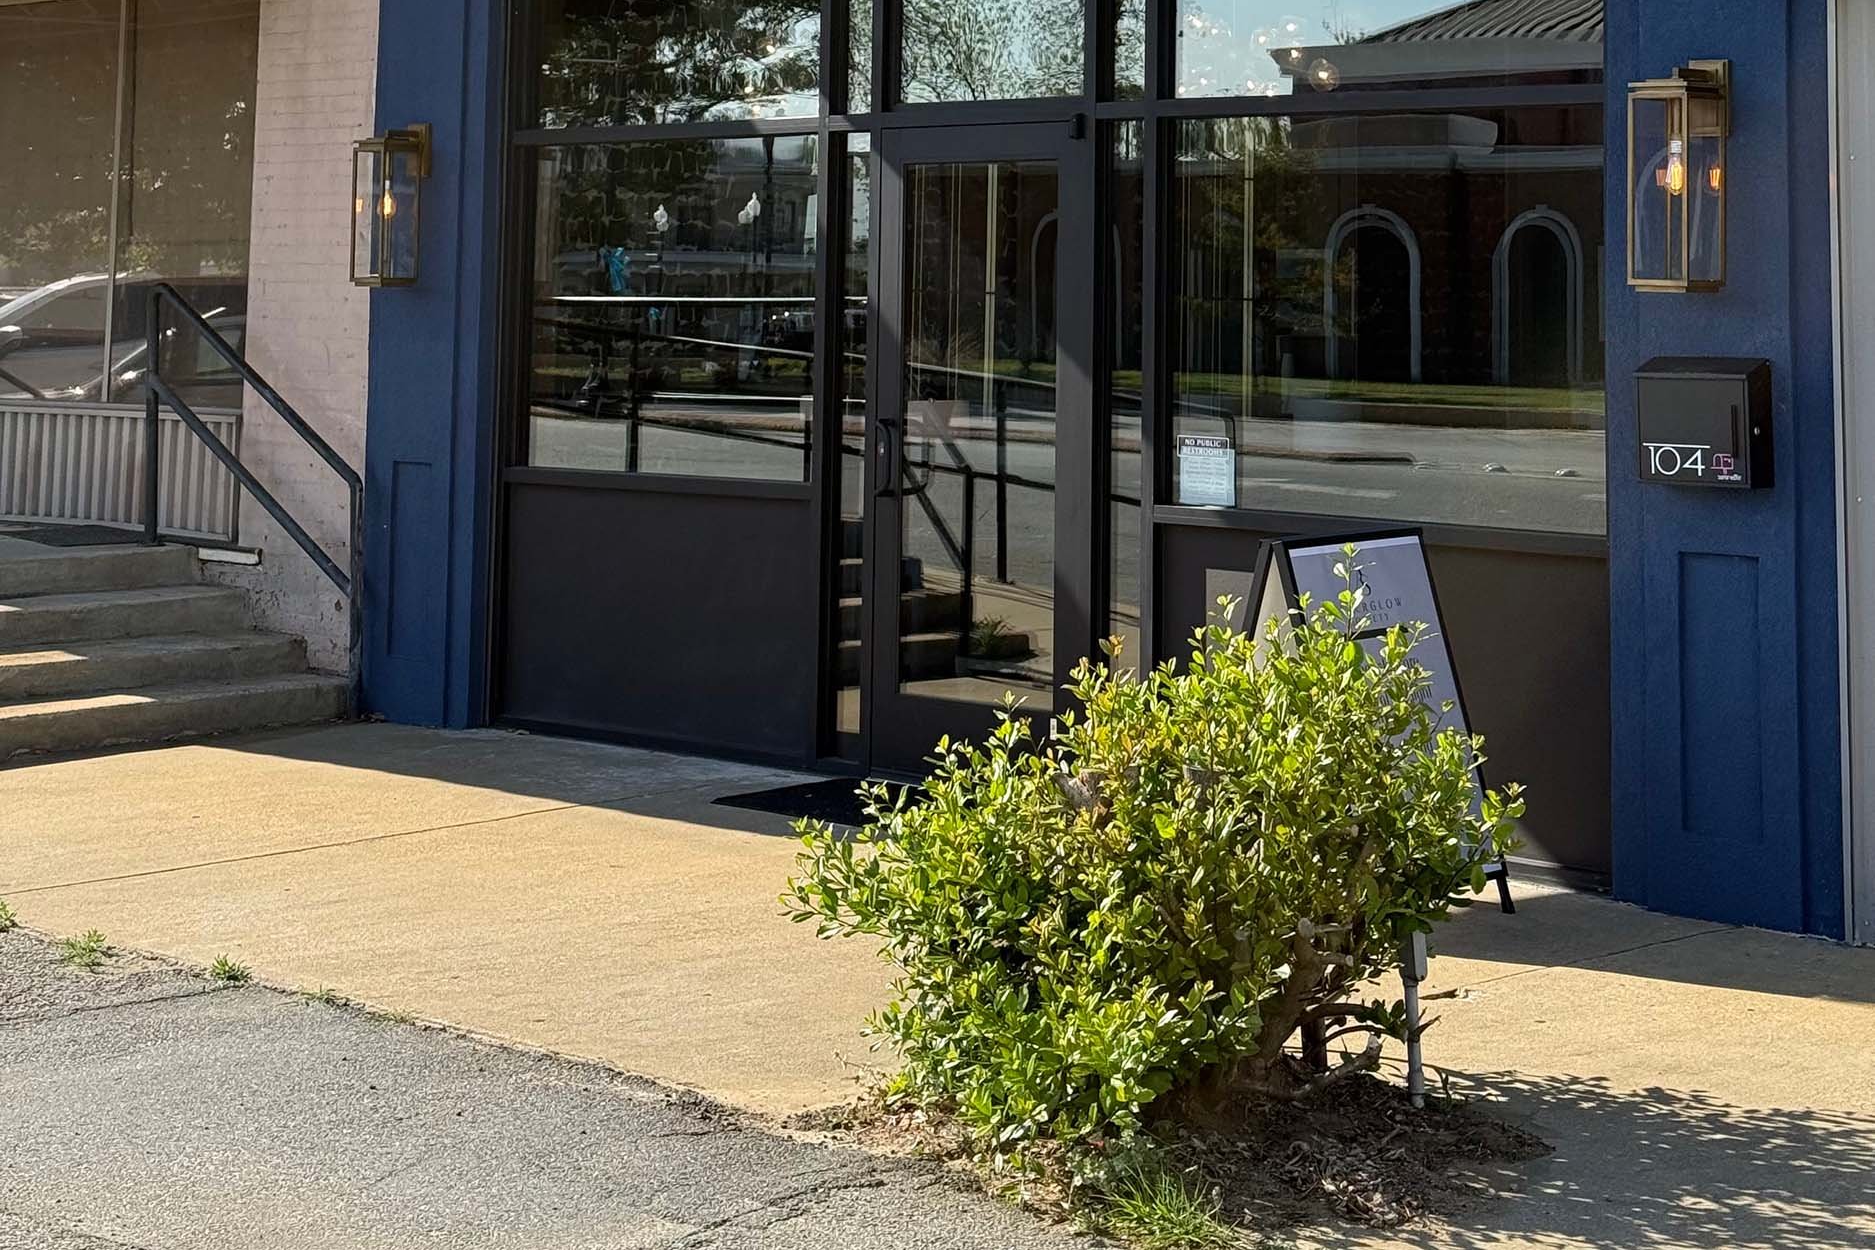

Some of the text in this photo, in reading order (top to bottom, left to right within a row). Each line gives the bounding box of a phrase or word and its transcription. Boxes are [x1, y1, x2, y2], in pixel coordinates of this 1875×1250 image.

[1184, 438, 1222, 448] NO PUBLIC
[1648, 446, 1706, 477] 104
